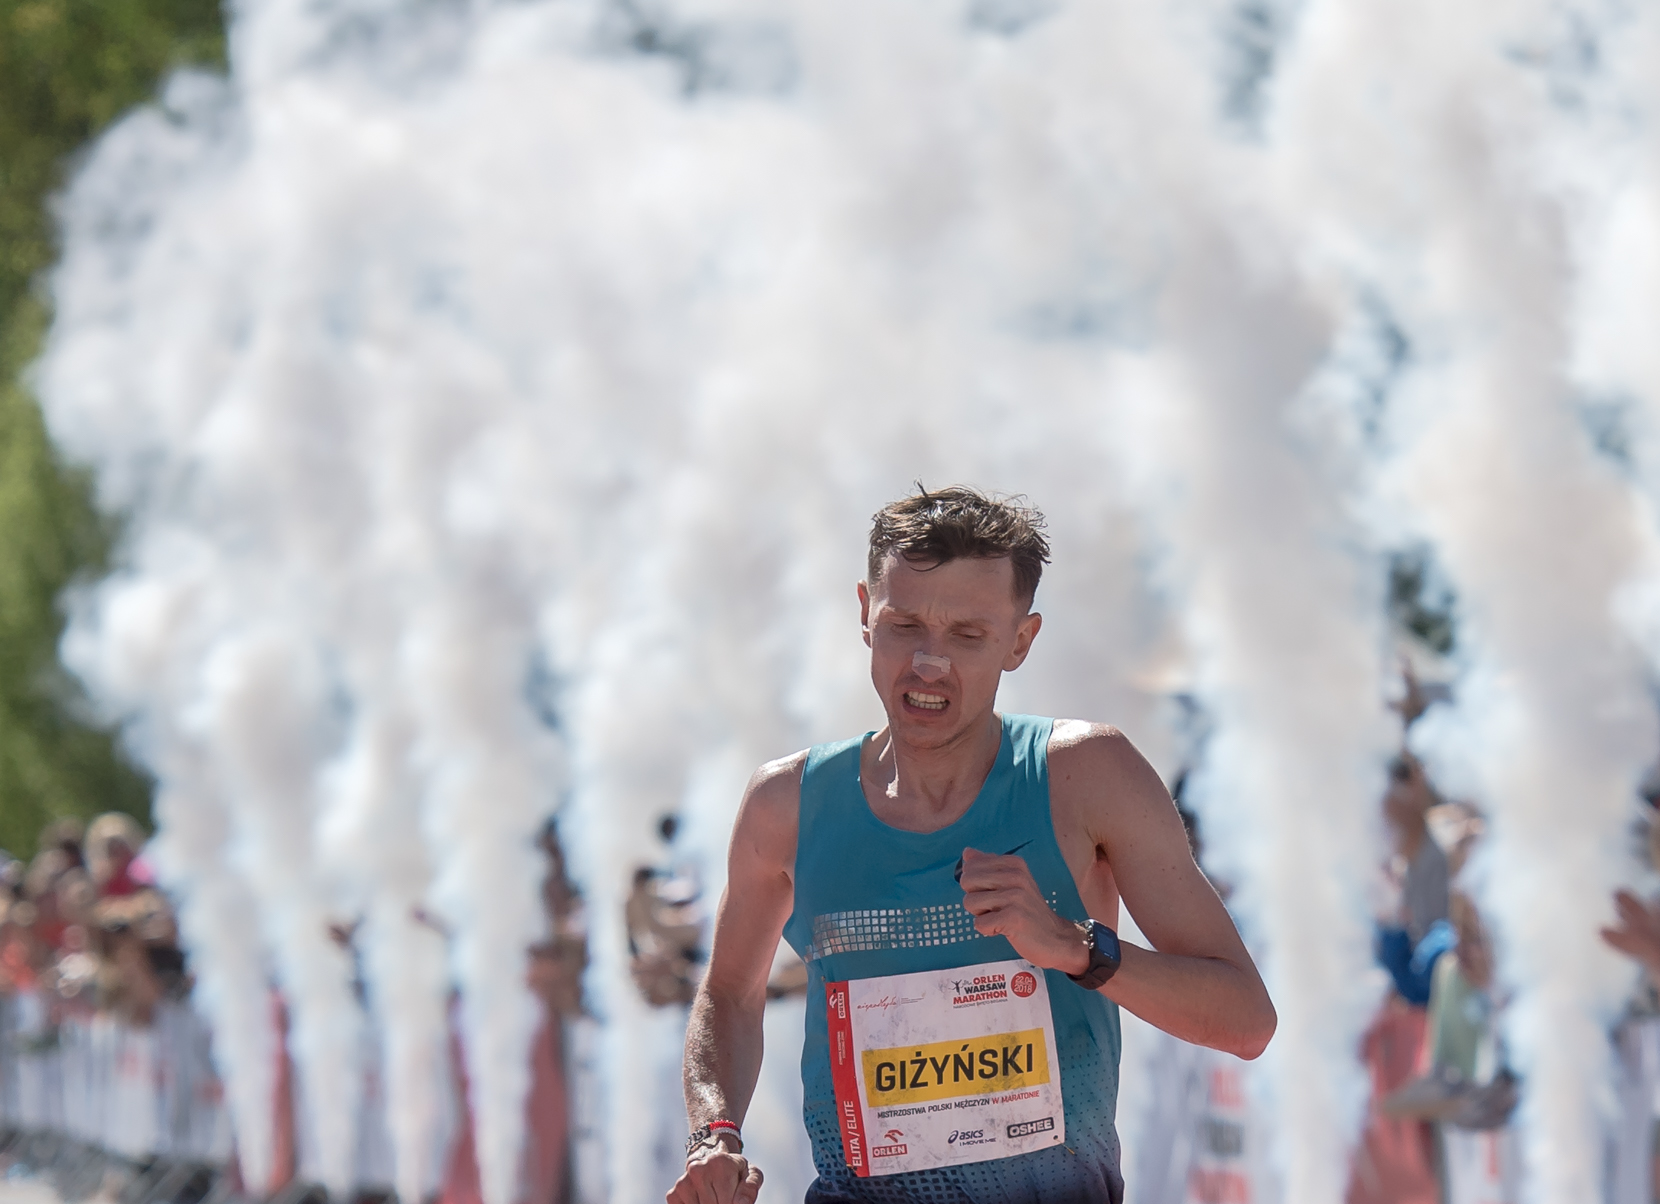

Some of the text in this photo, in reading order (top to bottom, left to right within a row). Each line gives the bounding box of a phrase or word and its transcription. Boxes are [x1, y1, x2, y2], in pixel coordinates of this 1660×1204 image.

[973, 974, 1005, 985] ORLEN
[964, 982, 1006, 995] WARSAW
[1014, 984, 1032, 994] 2018
[953, 990, 1007, 1005] MARATHON
[876, 1043, 1033, 1092] GIŻYŃSKI
[877, 1090, 1040, 1119] MISTRZOSTWA POLSKI MĘŻCZYZN W MARATONIE
[1009, 1120, 1053, 1136] OSHEE
[873, 1145, 906, 1157] ORLEN
